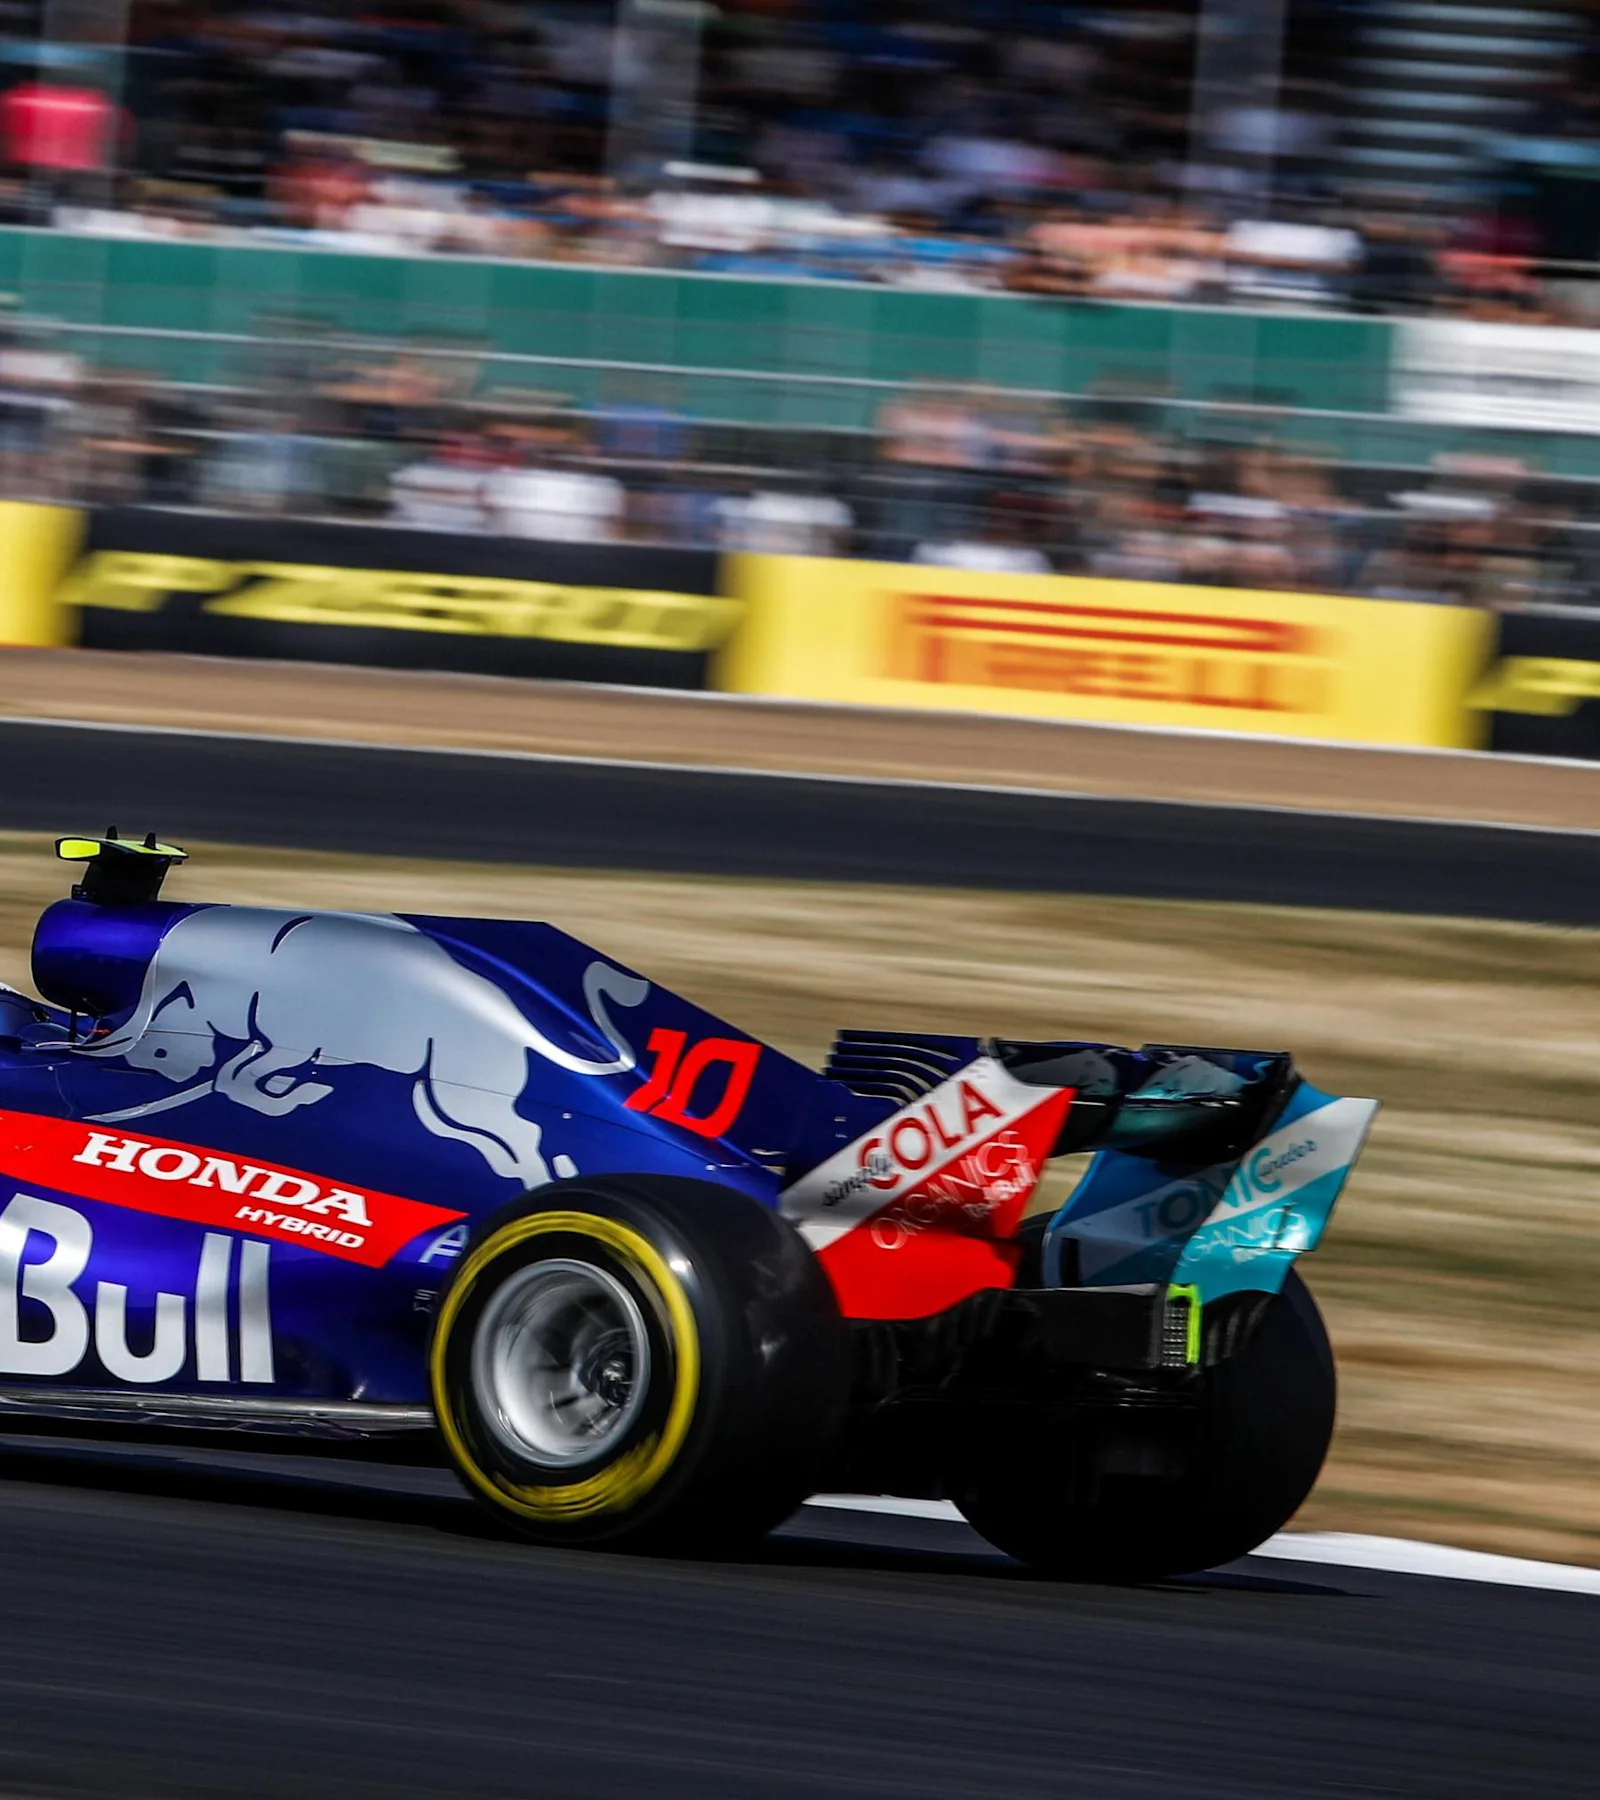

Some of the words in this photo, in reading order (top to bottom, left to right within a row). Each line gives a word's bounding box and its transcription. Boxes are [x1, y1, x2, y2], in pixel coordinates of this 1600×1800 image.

[623, 1027, 763, 1138] 10
[72, 1131, 373, 1227] HONDA
[858, 1079, 1006, 1190] COLA
[234, 1205, 366, 1249] HYBRID
